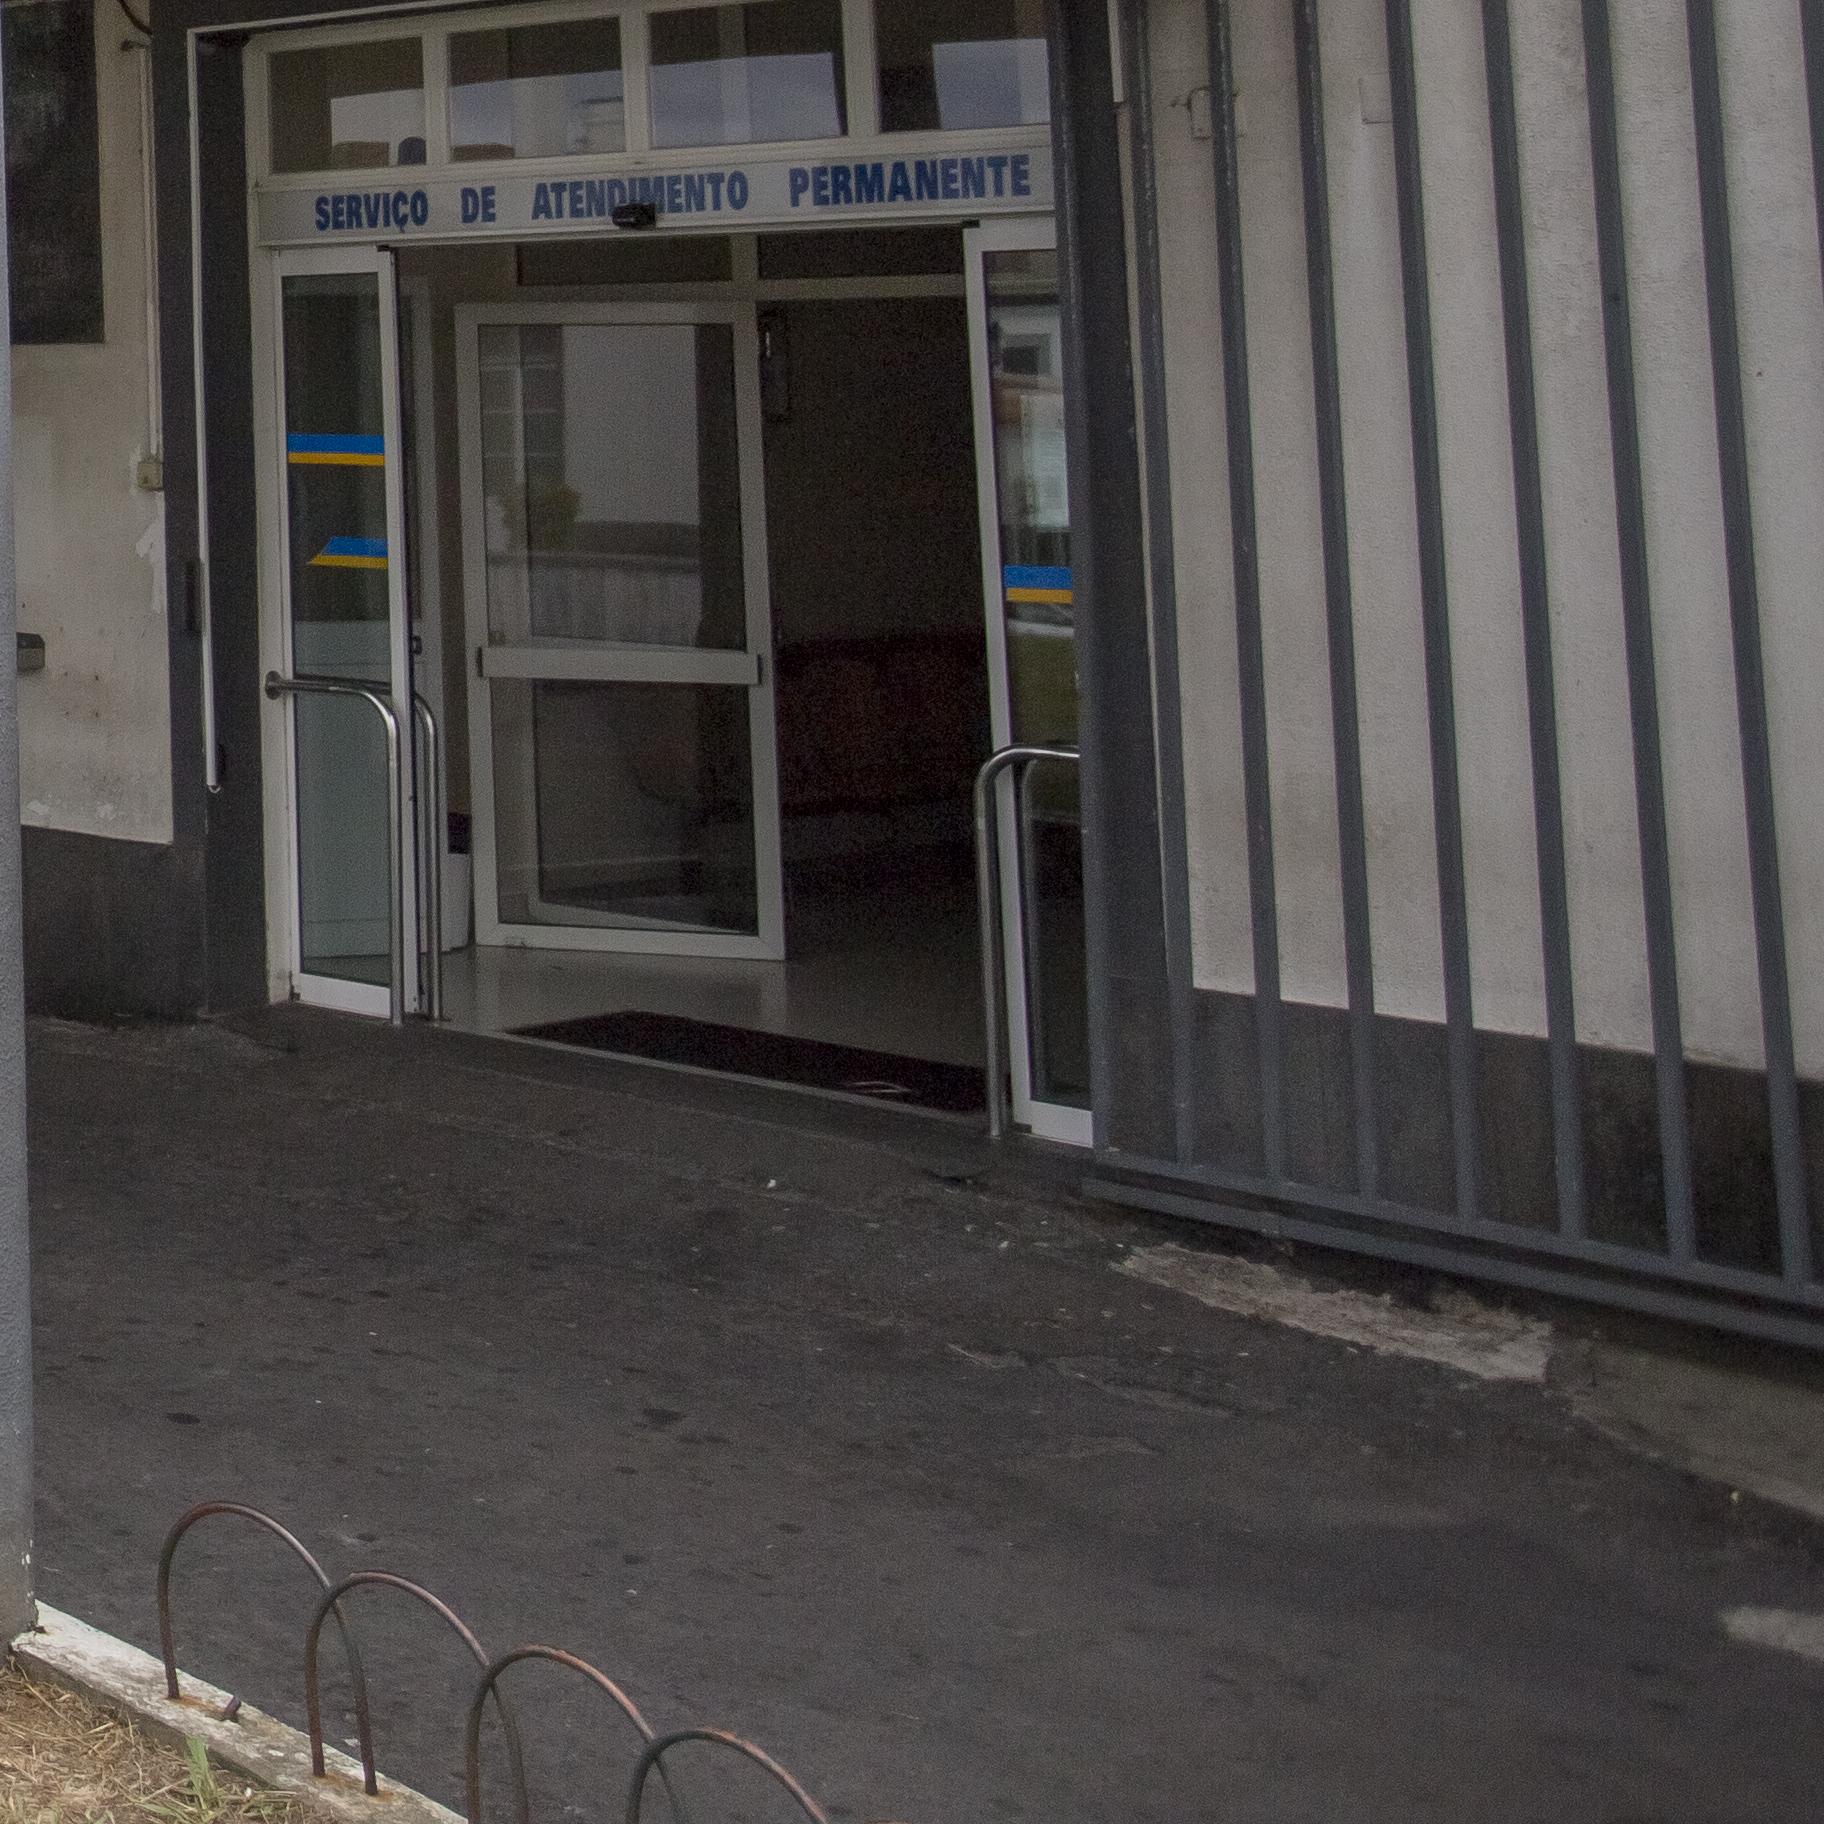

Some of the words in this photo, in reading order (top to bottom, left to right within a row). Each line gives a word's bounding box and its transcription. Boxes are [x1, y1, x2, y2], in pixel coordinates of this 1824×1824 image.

[315, 186, 429, 233] SERVIÇO
[460, 184, 496, 224] DE
[531, 170, 749, 221] ATENDIMENTO
[788, 154, 1031, 208] PERMANENTE
